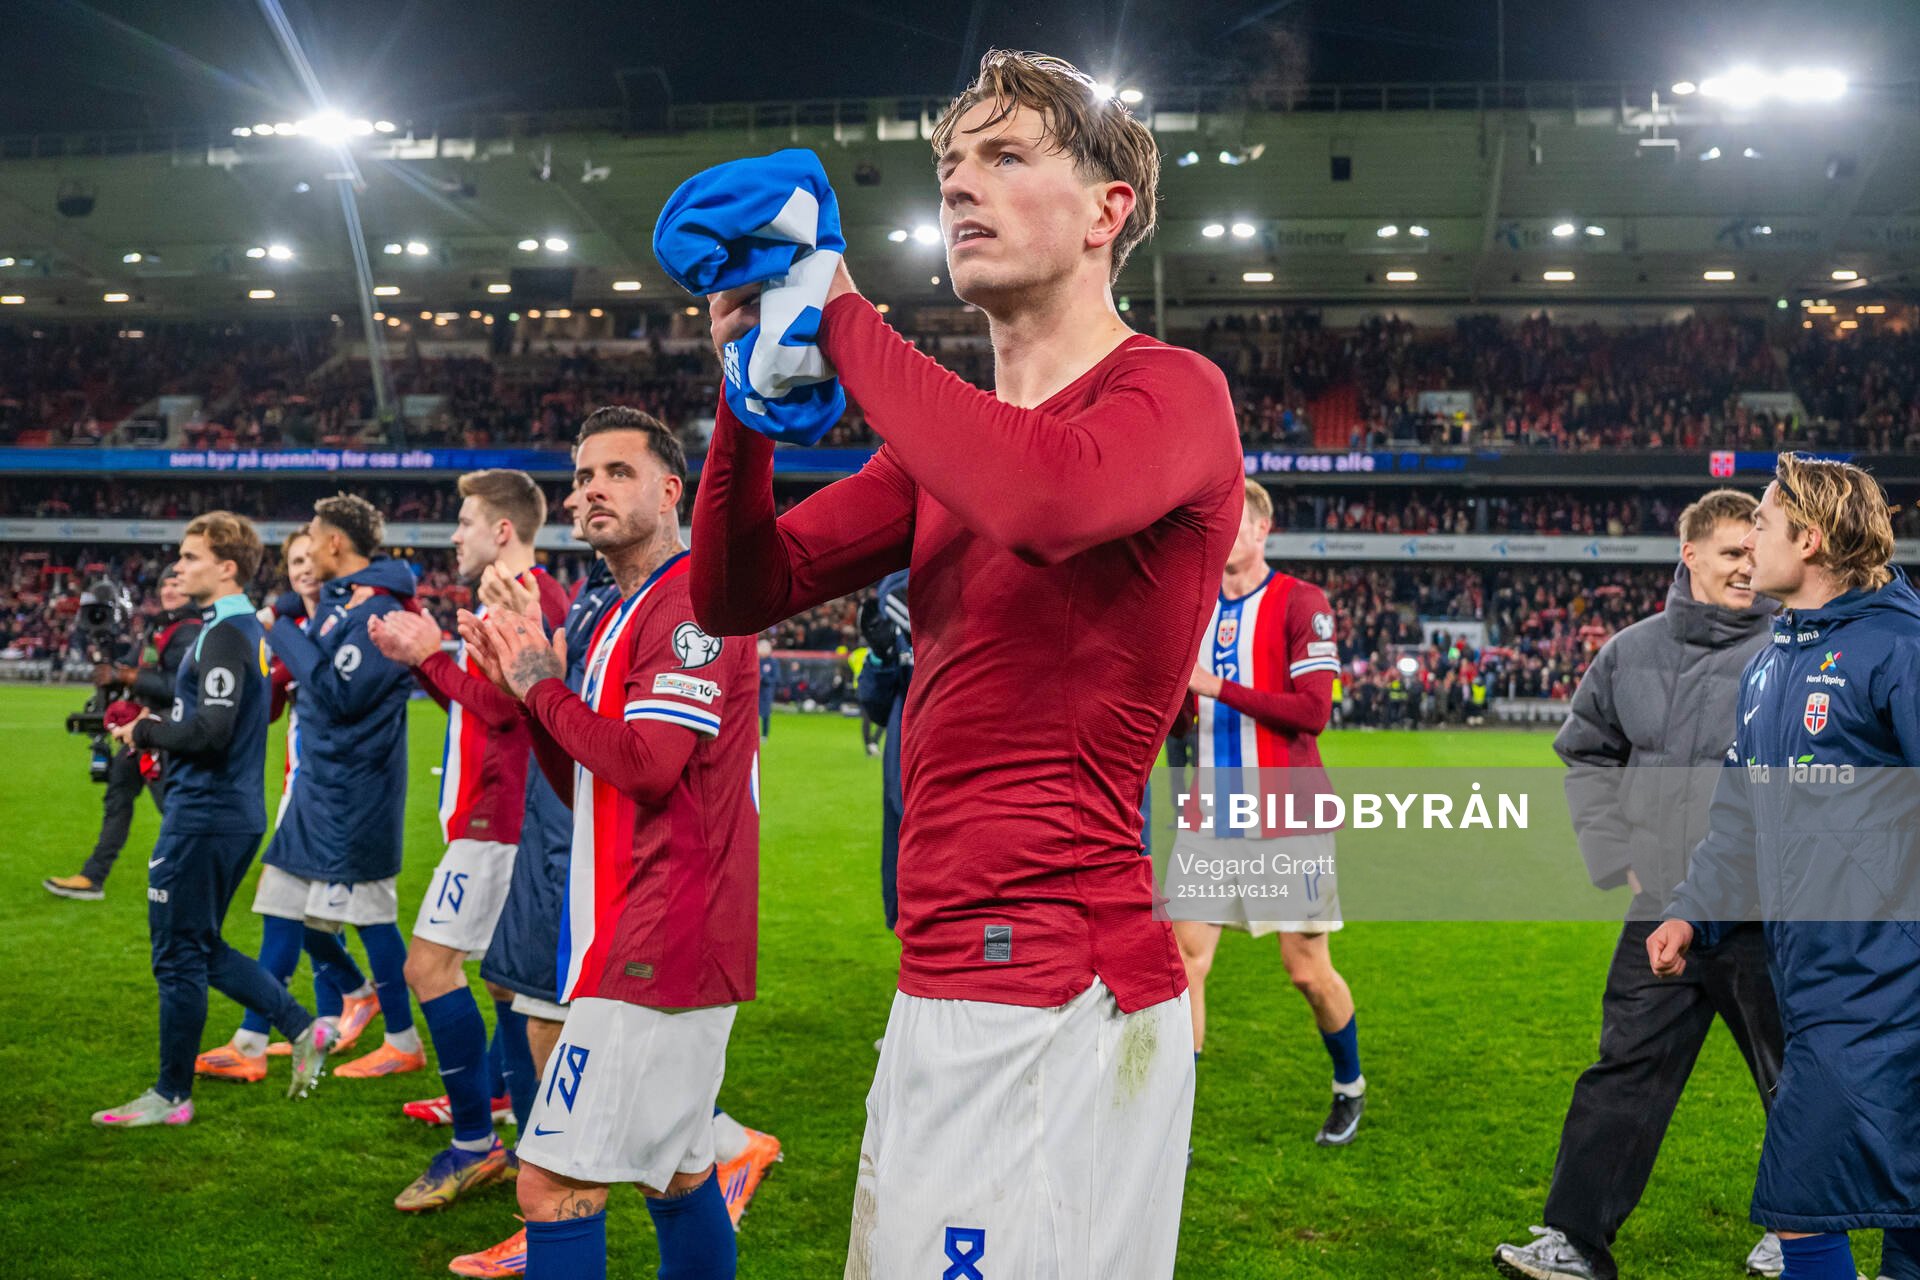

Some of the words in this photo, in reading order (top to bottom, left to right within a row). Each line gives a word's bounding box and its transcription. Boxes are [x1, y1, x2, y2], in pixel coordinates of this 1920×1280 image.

[261, 449, 339, 471] spenning
[342, 450, 367, 467] for
[1261, 452, 1292, 471] for
[1296, 456, 1332, 471] oss
[1335, 452, 1375, 471] alle
[437, 871, 469, 914] 15
[547, 1042, 590, 1114] 19
[942, 1226, 986, 1280] 8
